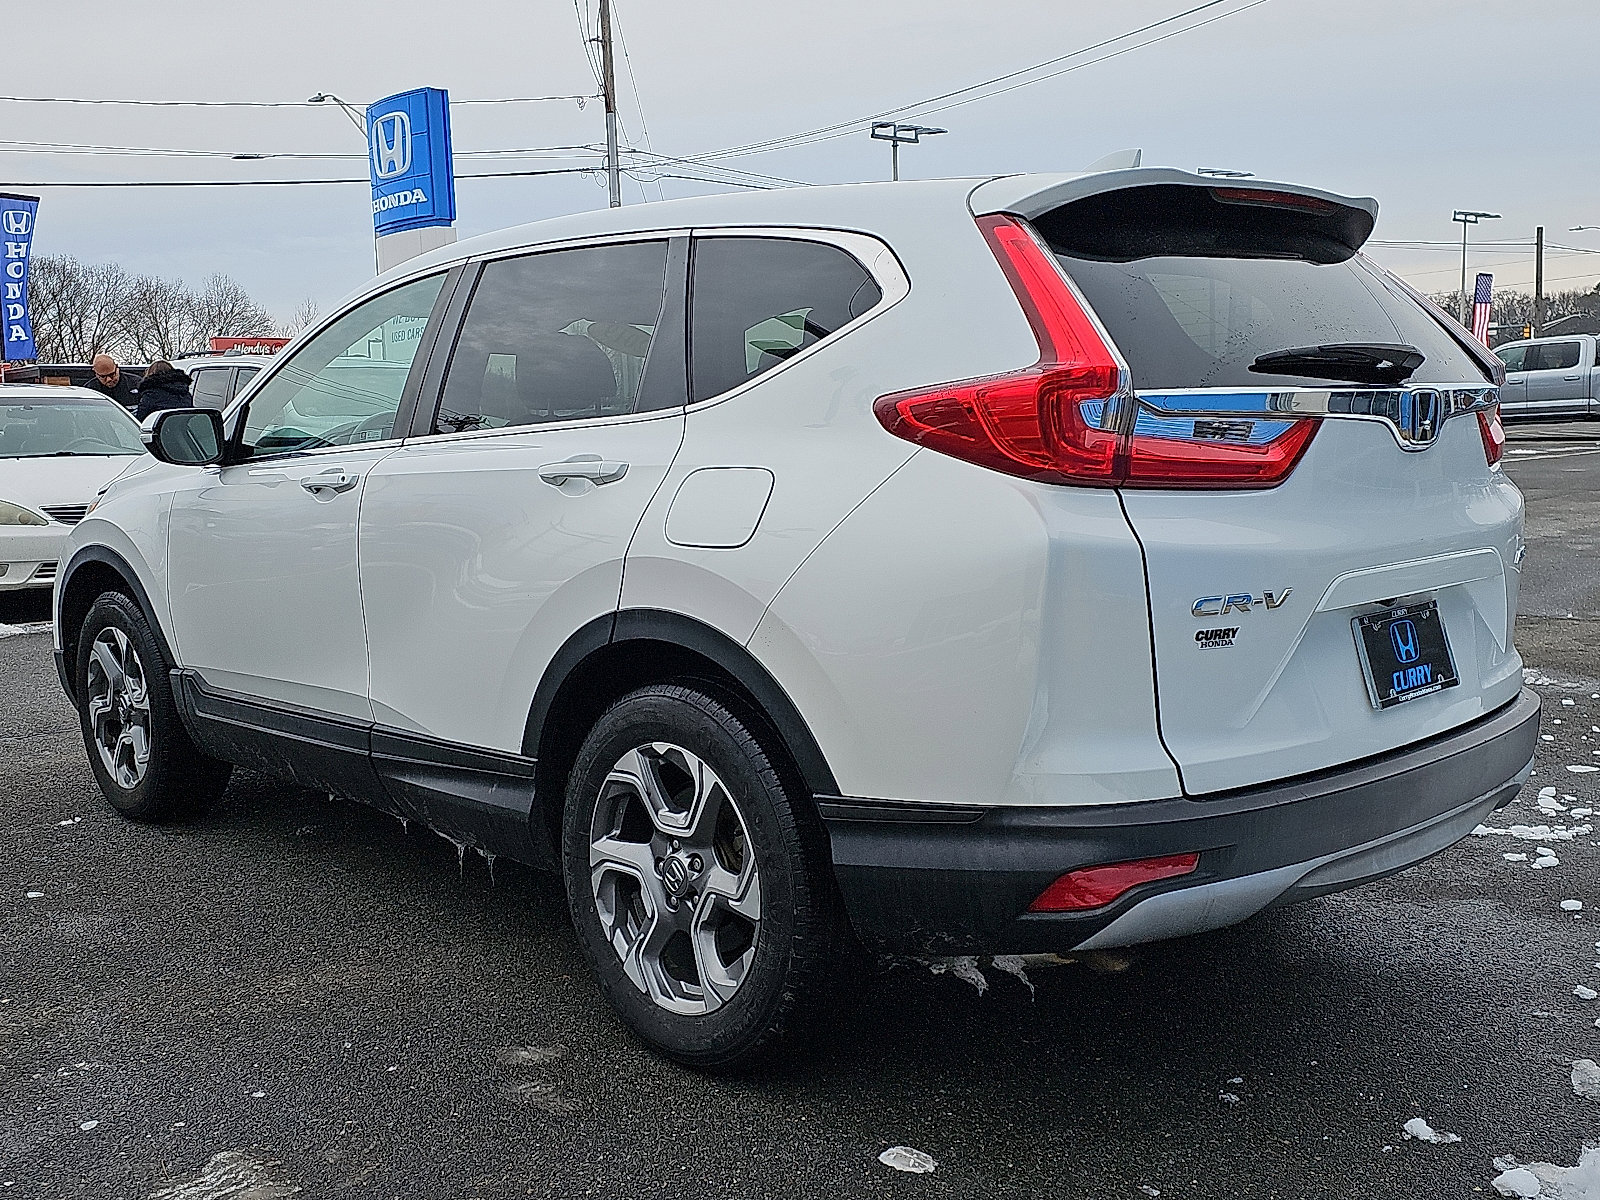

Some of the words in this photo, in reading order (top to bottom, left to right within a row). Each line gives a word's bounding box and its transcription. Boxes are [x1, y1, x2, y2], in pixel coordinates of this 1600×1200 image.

[371, 188, 428, 214] HONDA
[4, 241, 29, 343] HONDA
[391, 330, 406, 343] USED
[407, 326, 424, 341] CARS
[233, 341, 271, 355] Wendy's
[1191, 587, 1294, 617] CR-V
[1391, 608, 1408, 618] CURRY
[1194, 627, 1240, 642] CURRY
[1200, 639, 1235, 649] HONDA
[1393, 663, 1433, 692] CURRY
